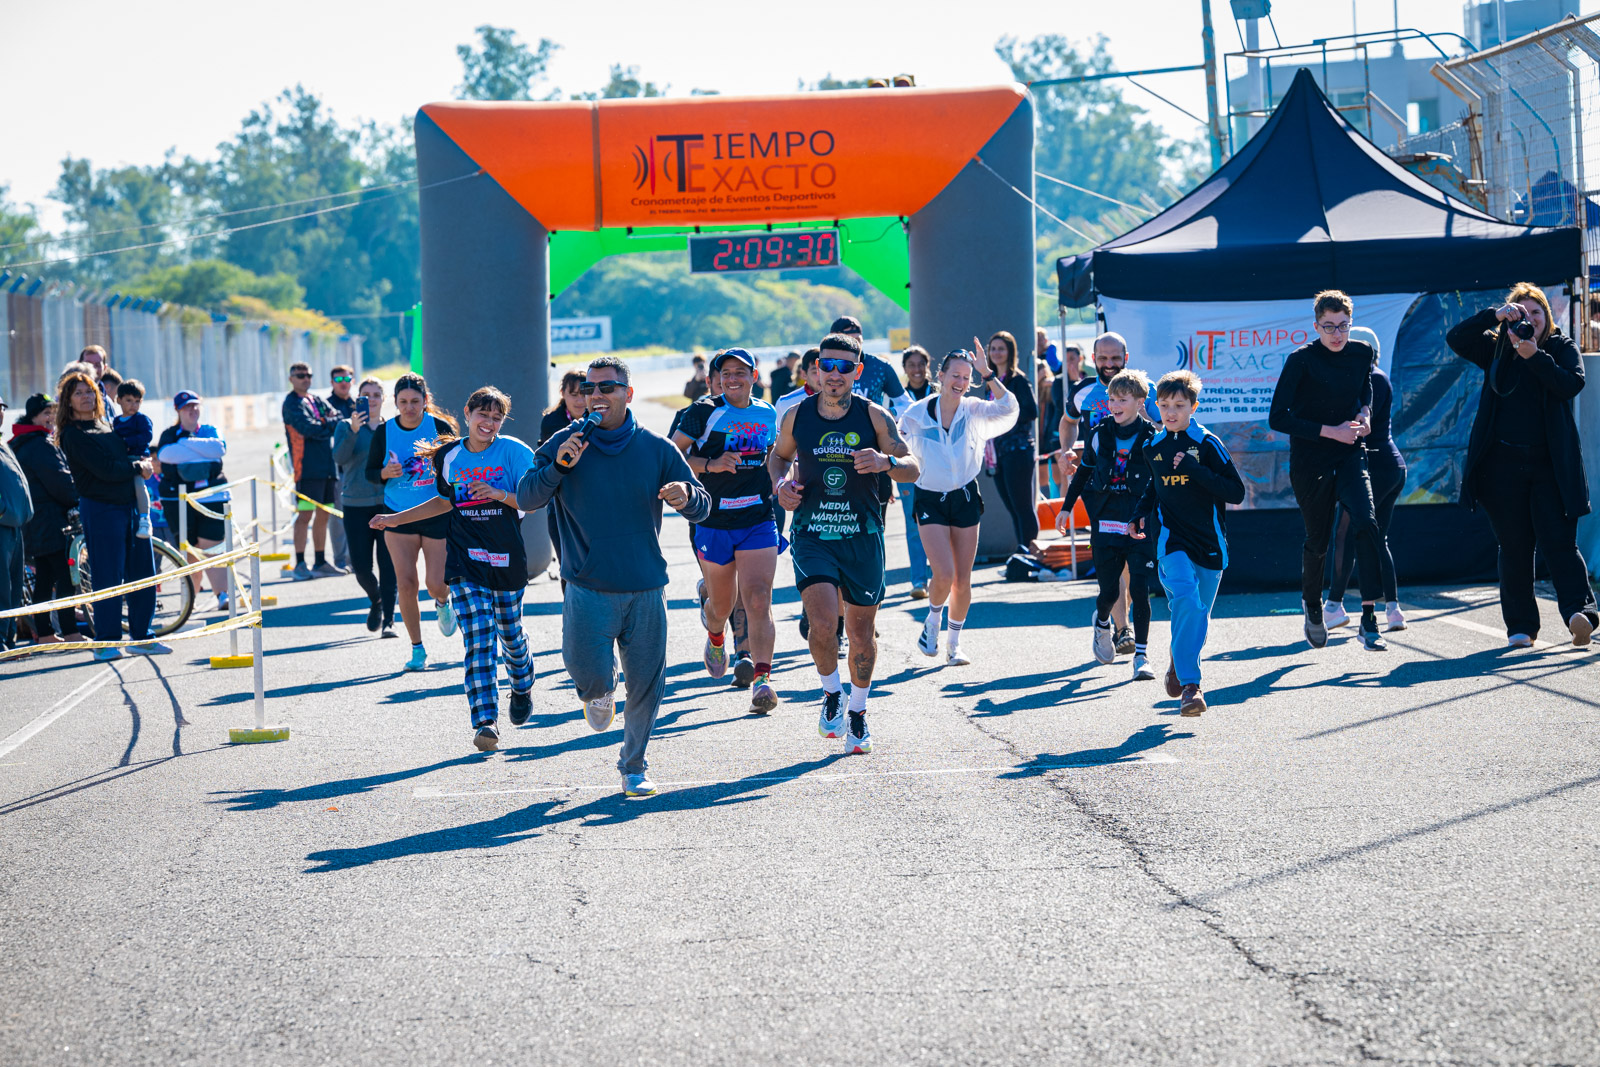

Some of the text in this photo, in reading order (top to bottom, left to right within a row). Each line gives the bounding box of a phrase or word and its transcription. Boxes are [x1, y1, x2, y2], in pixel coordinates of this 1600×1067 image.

[686, 142, 836, 193] EXACTO
[631, 192, 836, 207] Cronometraje de Eventos Deportivos
[713, 233, 835, 270] 2:09:30
[1213, 339, 1290, 370] EXACT
[848, 434, 856, 444] 3
[827, 474, 842, 485] SF
[1161, 475, 1189, 486] YPF
[819, 501, 851, 511] MEDIA
[811, 512, 858, 523] MARATÓN
[807, 523, 861, 534] NOCTURNA
